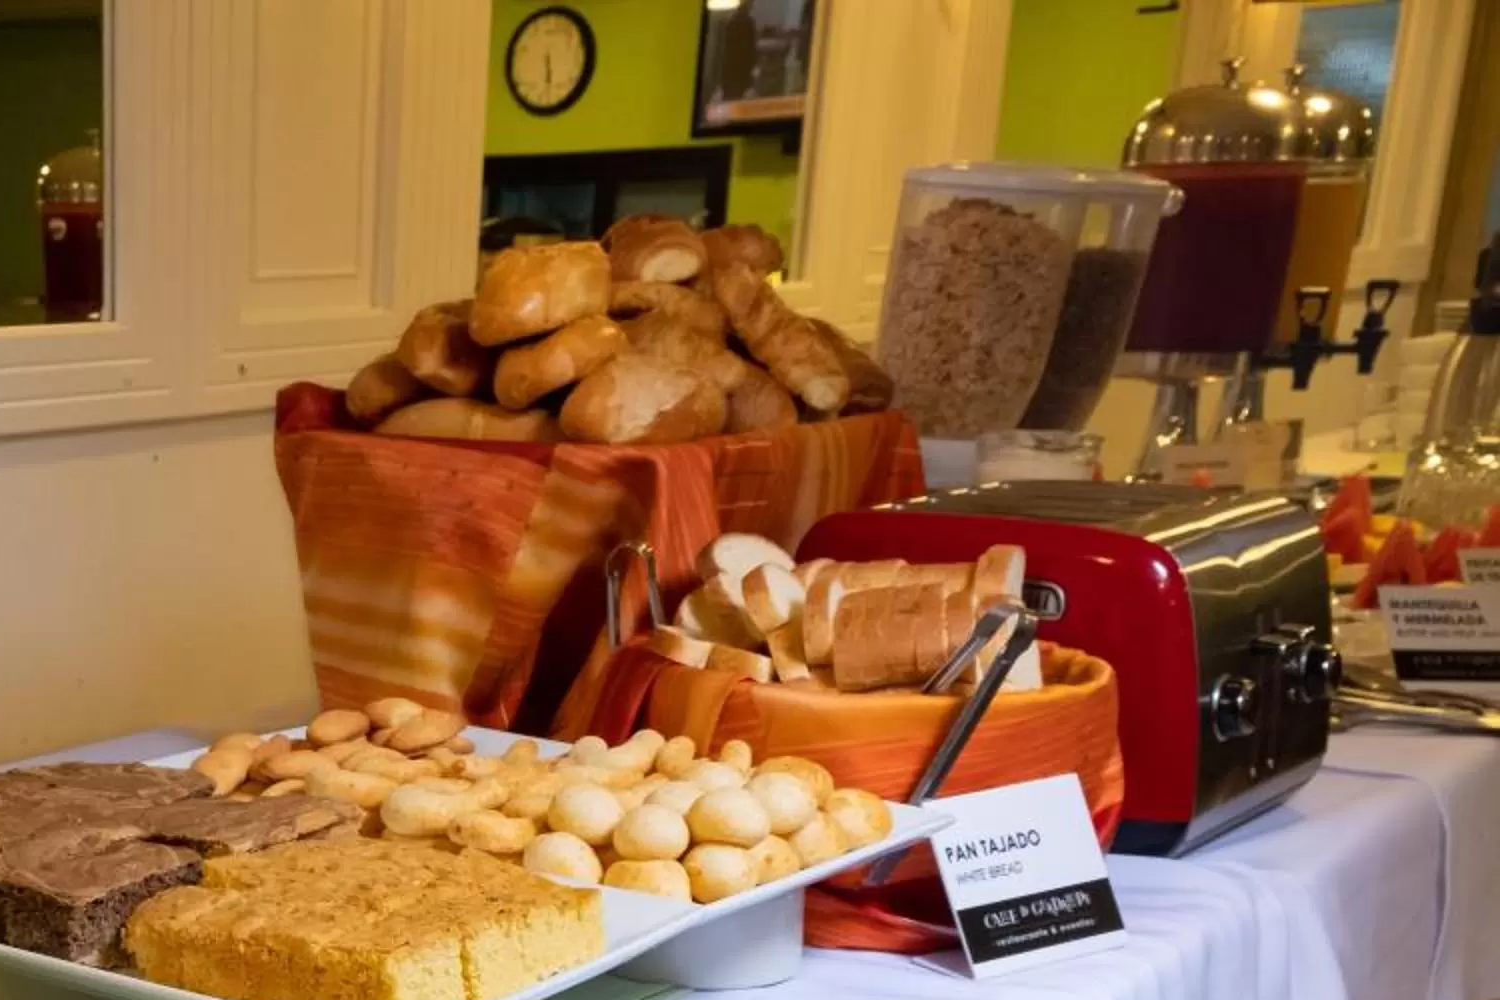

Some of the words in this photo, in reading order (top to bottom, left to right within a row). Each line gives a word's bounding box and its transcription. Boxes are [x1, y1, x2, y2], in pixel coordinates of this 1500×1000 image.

[945, 842, 978, 864] PAN
[980, 829, 1041, 857] TAJADO
[956, 867, 987, 886] WHITE
[988, 861, 1025, 879] BREAD
